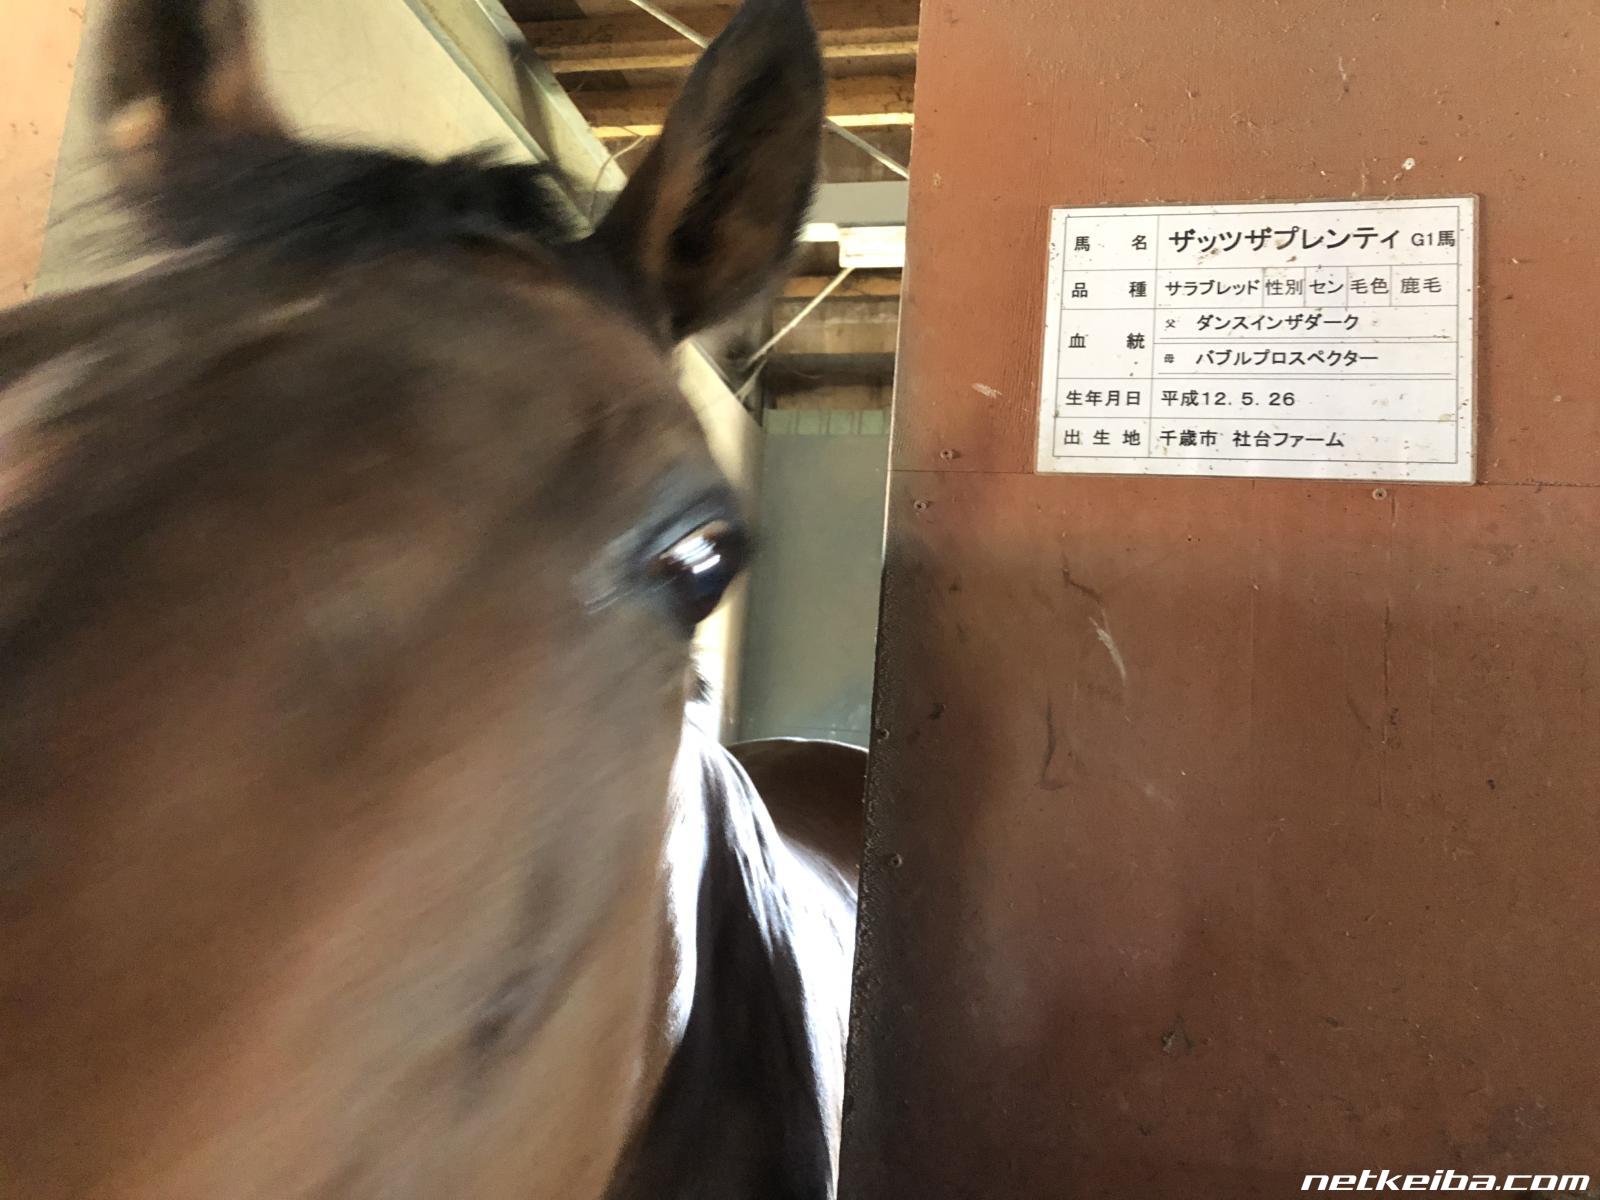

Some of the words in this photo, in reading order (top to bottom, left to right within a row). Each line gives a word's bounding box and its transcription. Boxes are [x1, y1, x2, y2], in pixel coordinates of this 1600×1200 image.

[1169, 226, 1400, 253] ザッツザプレンティ
[1411, 230, 1456, 247] G1馬
[1165, 279, 1260, 296] サラブレッド
[1265, 279, 1303, 296] 性別
[1309, 280, 1344, 294] セン
[1350, 278, 1390, 295] 毛色
[1400, 277, 1442, 294] 鹿毛
[1165, 318, 1176, 329] 父
[1196, 313, 1359, 331] ダンスインザダーク
[1195, 349, 1378, 366] バブルプロスペクター
[1065, 389, 1141, 406] 生年月日
[1159, 430, 1217, 447] 千歳市
[1232, 431, 1344, 447] 社台ファーム
